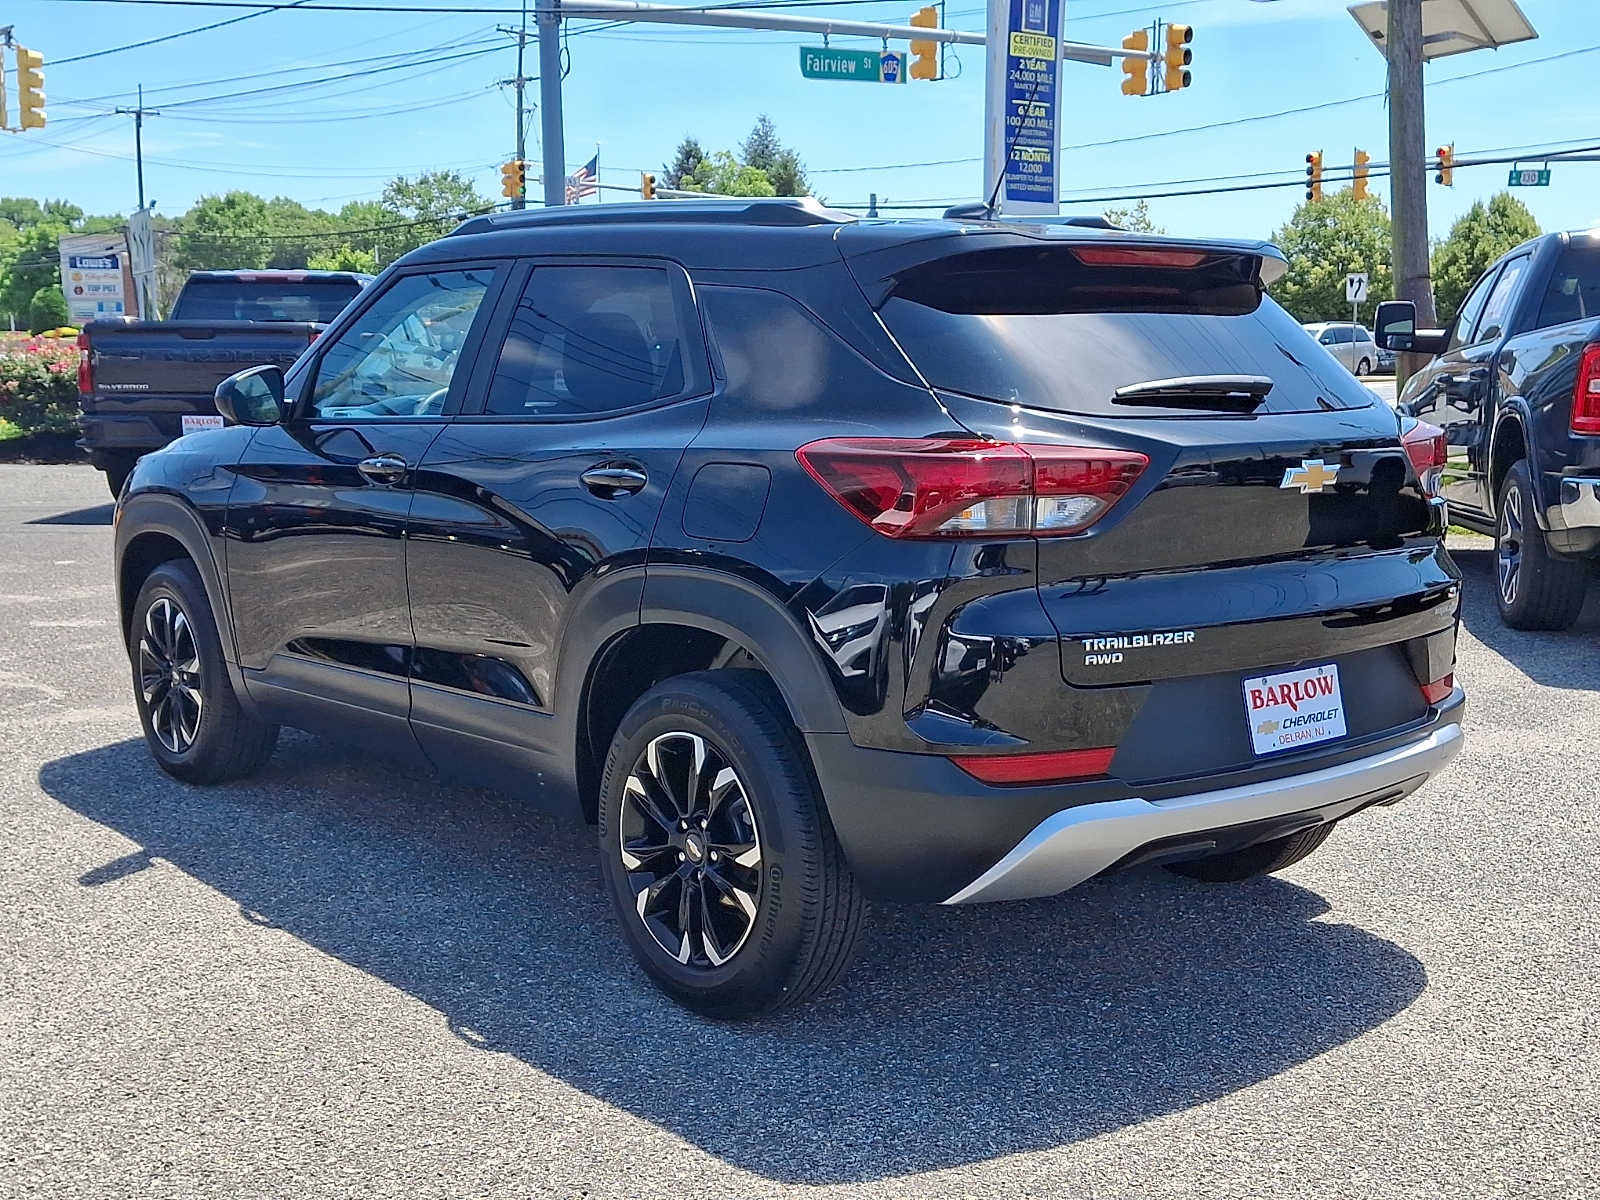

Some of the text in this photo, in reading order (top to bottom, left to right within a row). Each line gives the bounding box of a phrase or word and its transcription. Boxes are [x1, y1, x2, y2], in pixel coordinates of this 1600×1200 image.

[1013, 35, 1053, 48] CERTIFIED
[1013, 45, 1052, 57] PRE-OWNED
[806, 54, 856, 73] Fairview
[883, 60, 898, 74] 605
[1019, 59, 1047, 71] 2 YEAR
[1037, 72, 1053, 83] MILE
[1018, 106, 1024, 115] 6
[1006, 116, 1053, 128] 100000 MILE
[1021, 151, 1050, 162] MONTH
[184, 417, 220, 427] BARLOW
[1082, 631, 1195, 651] TRAILBLAZER
[1085, 653, 1123, 665] AWD
[1250, 675, 1334, 712] BARLOW
[1283, 708, 1339, 729] CHEVROLET
[1314, 727, 1325, 737] NJ
